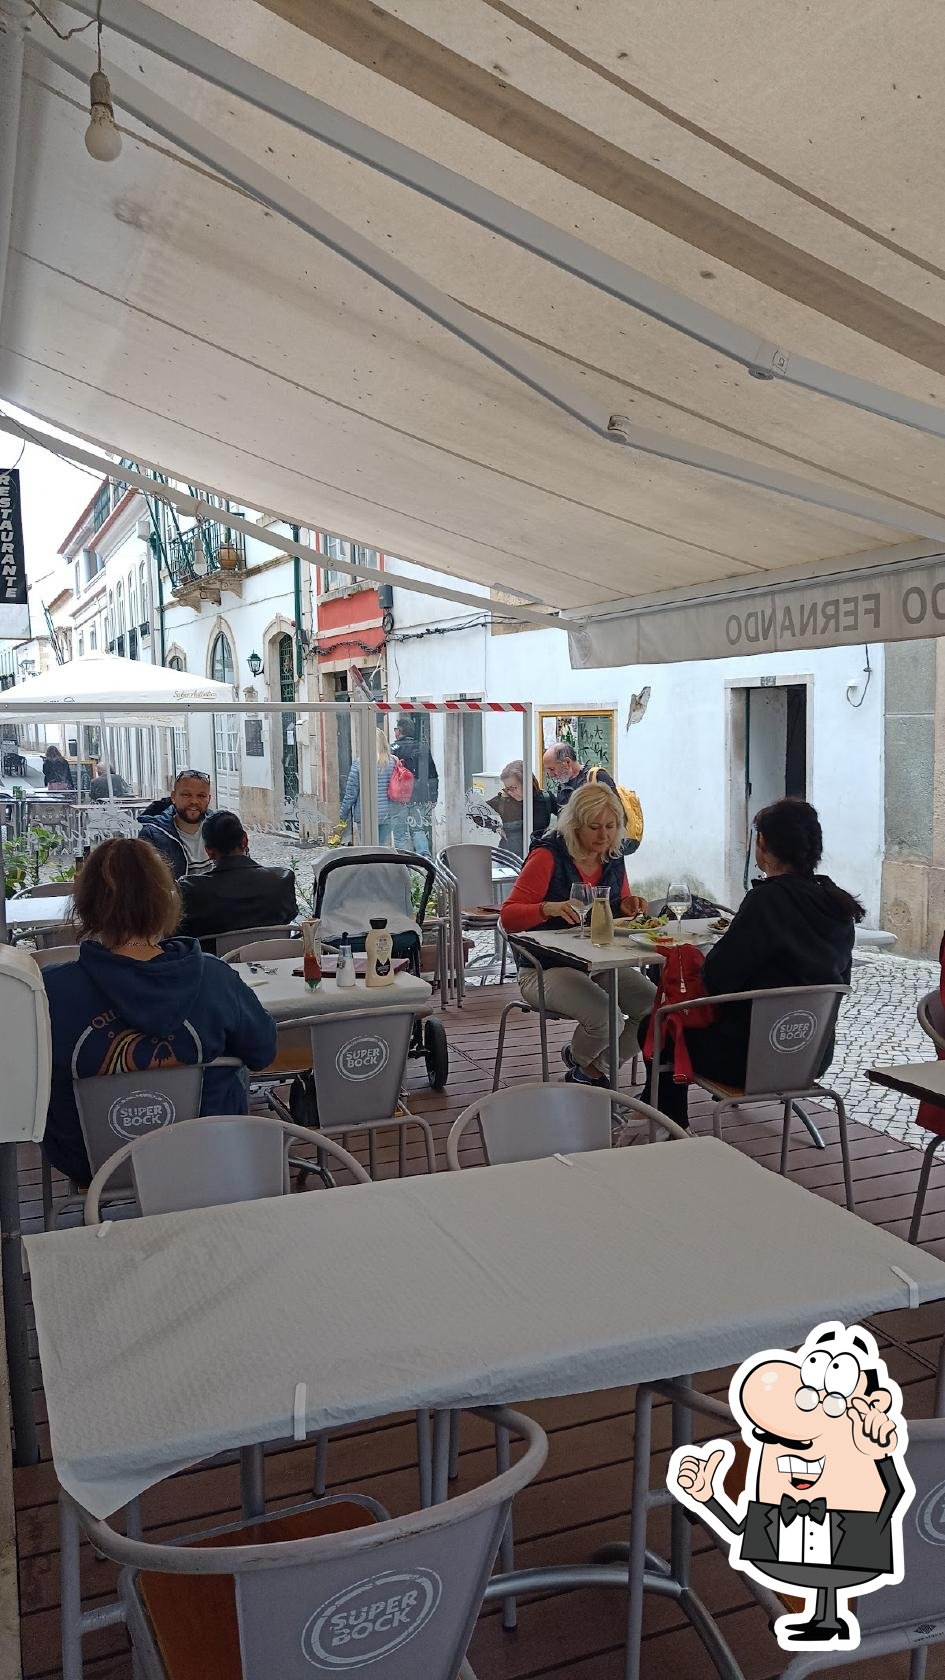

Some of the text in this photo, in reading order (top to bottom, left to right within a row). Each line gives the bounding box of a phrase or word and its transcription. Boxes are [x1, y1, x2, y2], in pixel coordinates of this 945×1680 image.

[0, 474, 17, 598] RESTAURANTE
[779, 1022, 810, 1033] SUPER
[779, 1030, 807, 1041] BOCK
[346, 1047, 380, 1061] SUPER
[347, 1056, 378, 1068] BOCK
[119, 1105, 163, 1118] SUPER
[123, 1115, 162, 1127] BOCK
[330, 1590, 418, 1631] SUPER
[331, 1607, 411, 1647] BOCK
